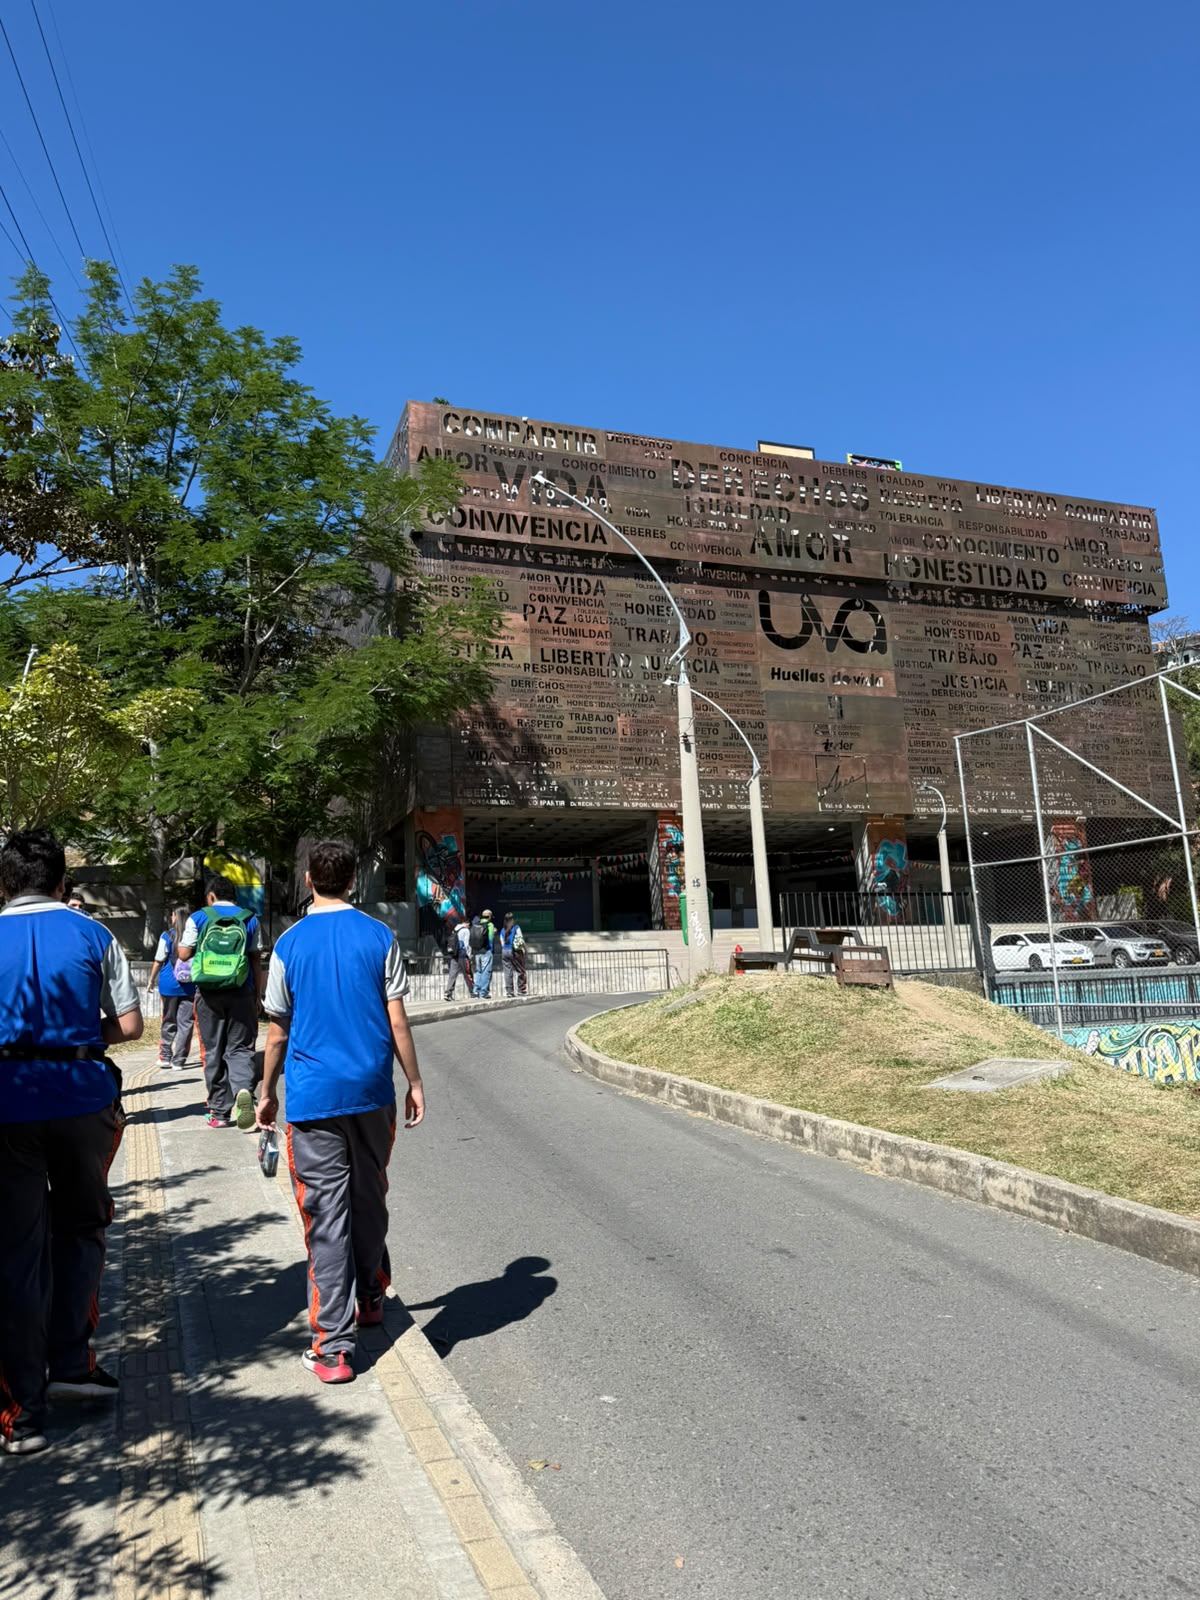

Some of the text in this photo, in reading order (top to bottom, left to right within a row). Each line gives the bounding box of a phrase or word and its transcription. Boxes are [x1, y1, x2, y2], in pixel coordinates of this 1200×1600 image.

[443, 412, 597, 455] COMPARTIR
[606, 431, 673, 450] DERECHOS
[481, 443, 544, 462] TRABAJO
[719, 451, 789, 469] CONCIENCIA
[562, 457, 656, 480] CONOCIMIENTO
[822, 465, 867, 479] DEBERES
[493, 461, 613, 514] VIDA
[671, 459, 870, 512] DERECHOS
[876, 473, 924, 488] IGUALDAD
[937, 482, 958, 493] VIDA
[879, 488, 963, 513] RESPETO
[975, 486, 1057, 512] LIBERTAD
[624, 506, 651, 519] VIDA
[685, 495, 791, 524] IGUALDAD
[1064, 503, 1152, 529] COMPARTIR
[427, 505, 608, 545] CONVIVENCIA
[667, 515, 743, 533] HONESTIDAD
[829, 519, 876, 533] LIBERTAD
[878, 510, 944, 527] TOLERANCIA
[615, 525, 666, 540] DEBERES
[958, 519, 1048, 540] RESPONSABILIDAD
[1099, 526, 1151, 543] TRABAJO
[670, 541, 743, 557] CONVIVENCIA
[750, 526, 853, 564] AMOR
[888, 536, 915, 546] AMOR
[922, 532, 1060, 564] CONOCIMIENTO
[1063, 536, 1109, 555] AMOR
[883, 552, 1047, 591] HONESTIDAD
[1082, 554, 1143, 573] RESPETO
[520, 572, 551, 583] AMOR
[1062, 573, 1156, 596] CONVIVENCIA
[554, 575, 607, 597] VIDA
[529, 593, 605, 609] CONVIVENCIA
[726, 589, 751, 600] VIDA
[523, 603, 567, 625] PAZ
[573, 614, 628, 626] IGUALDAD
[1006, 616, 1029, 624] AMOR
[941, 619, 996, 629] CONOCIMIENTO
[552, 626, 613, 640] HUMILDAD
[924, 626, 1001, 642] HONESTIDAD
[1014, 633, 1070, 645] CONVIVENCIA
[696, 647, 718, 657] PAZ
[958, 642, 976, 652] PAZ
[1010, 642, 1044, 660] PAZ
[541, 648, 632, 668] LIBERTAD
[894, 660, 934, 670] JUSTICIA
[928, 648, 998, 666] TRABAJO
[523, 662, 634, 680] RESPONSABILIDAD
[771, 667, 825, 682] Huellas
[511, 679, 565, 690] DERECHOS
[941, 674, 1008, 692] JUSTICIA
[931, 688, 978, 698] DERECHOS
[568, 712, 614, 722] TRABAJO
[914, 708, 937, 717] VIDA
[517, 719, 564, 729] RESPETO
[574, 725, 617, 735] JUSTICIA
[904, 722, 921, 731] PAZ
[908, 739, 948, 748] LIBERTAD
[467, 750, 497, 761] VIDA
[634, 756, 660, 766] VIDA
[920, 765, 943, 775] VIDA
